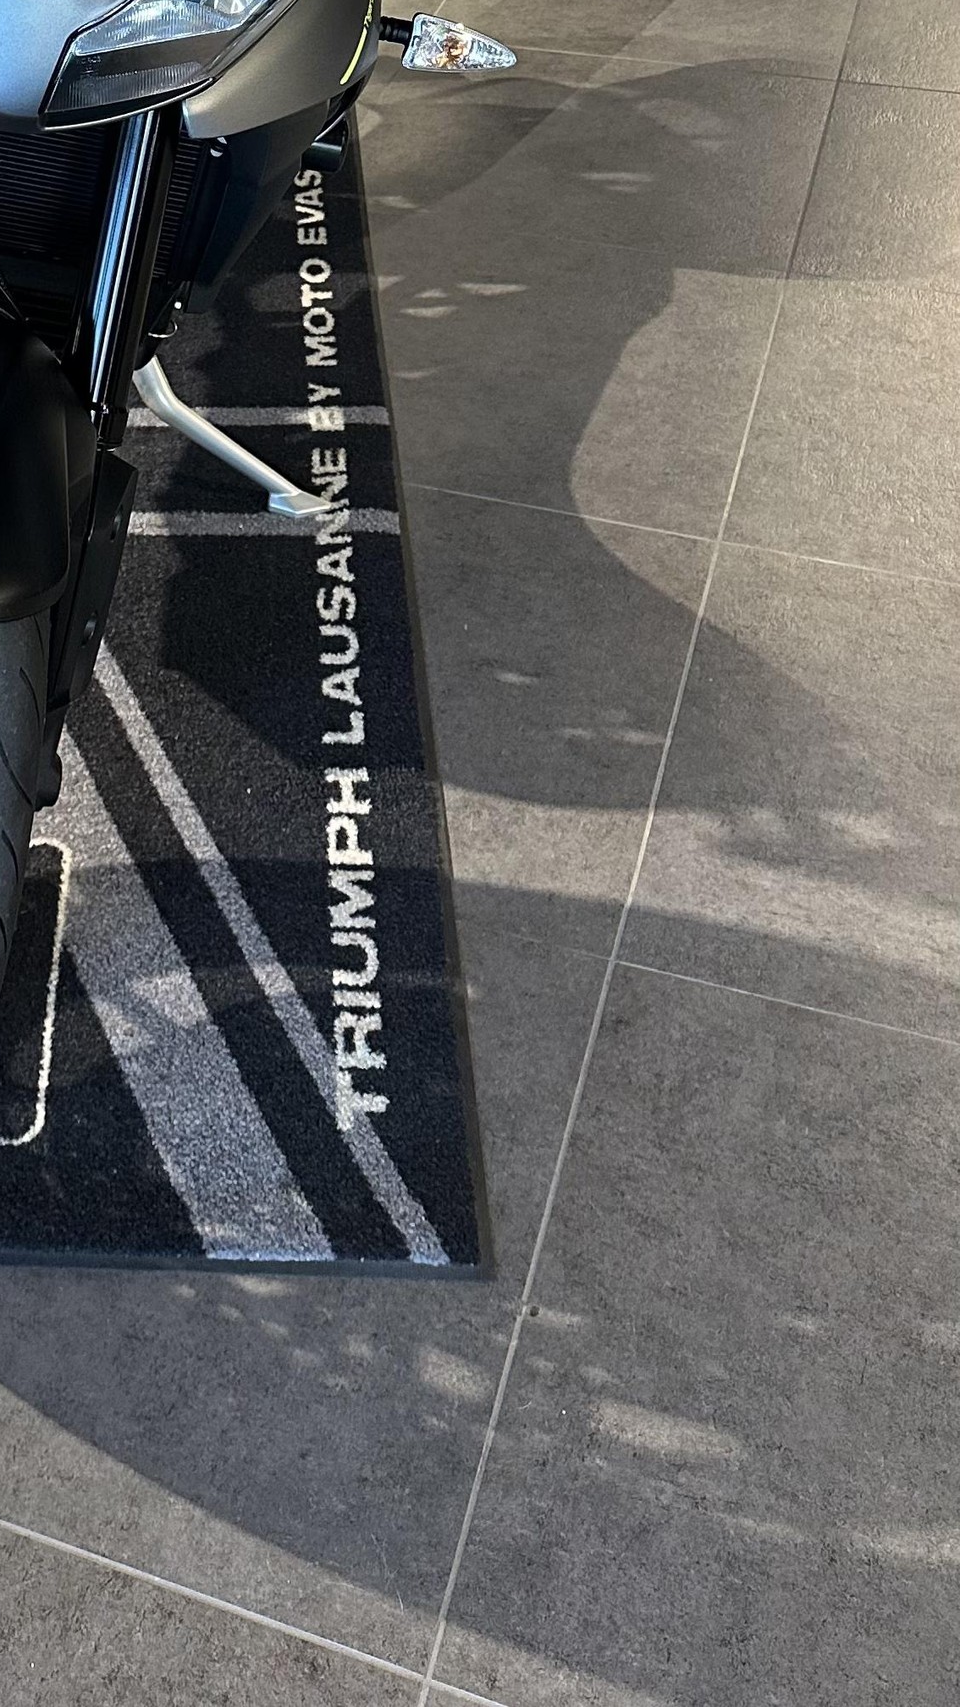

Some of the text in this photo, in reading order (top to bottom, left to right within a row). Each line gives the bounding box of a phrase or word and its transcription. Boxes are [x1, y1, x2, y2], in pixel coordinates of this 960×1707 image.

[294, 169, 391, 1132] TRIUMPH LAUSANNE BY MOTO EVAS
